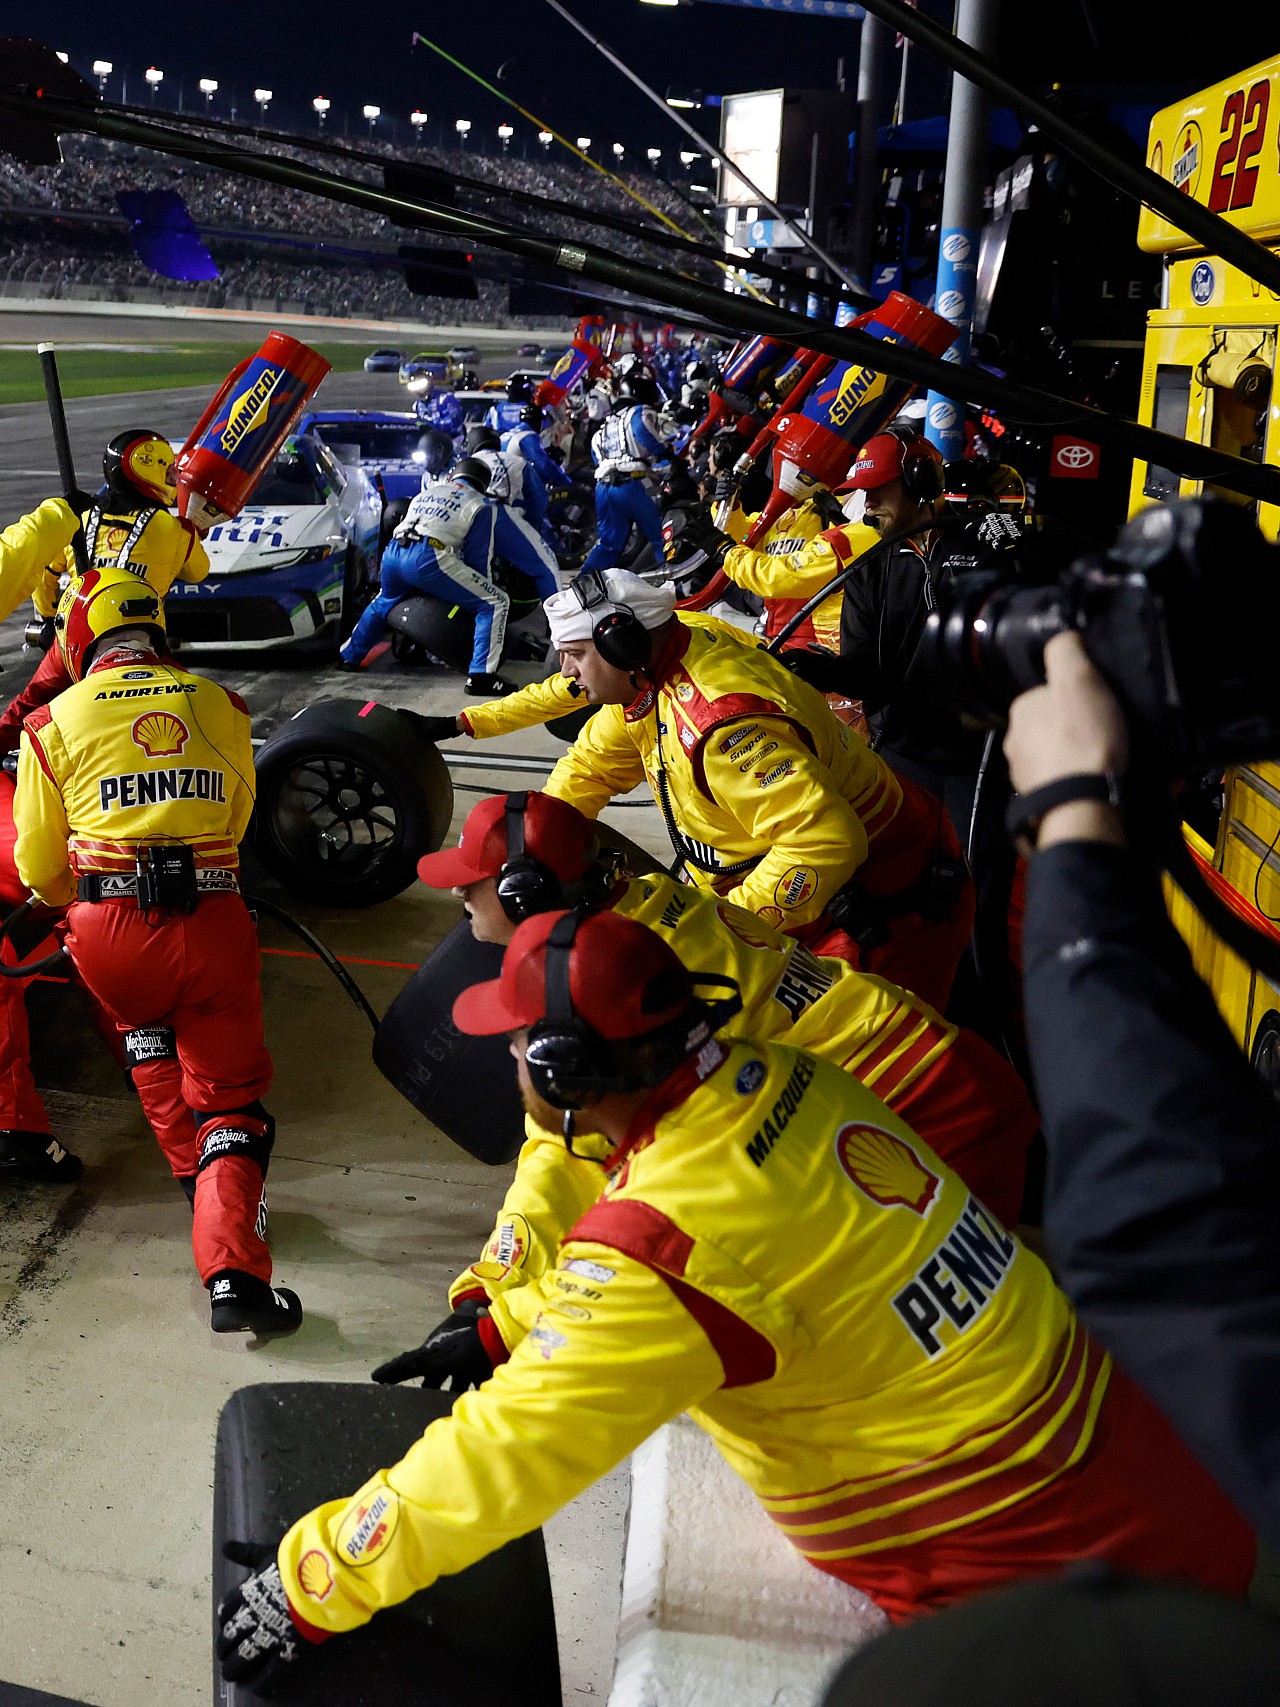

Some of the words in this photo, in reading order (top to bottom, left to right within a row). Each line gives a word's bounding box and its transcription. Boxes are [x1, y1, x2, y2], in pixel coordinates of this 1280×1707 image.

[1208, 79, 1271, 214] 22
[876, 267, 898, 284] 5
[222, 369, 277, 451] SUNOCO
[830, 366, 877, 427] SUNO
[94, 684, 199, 702] ANDREWS
[125, 671, 151, 680] Ford
[98, 767, 227, 813] PENNZOIL
[760, 758, 793, 788] SUNOCO
[202, 869, 233, 880] TEAM
[784, 870, 808, 907] PENNZOIL
[659, 893, 688, 929] WILL
[345, 1496, 389, 1560] PENNZOIL
